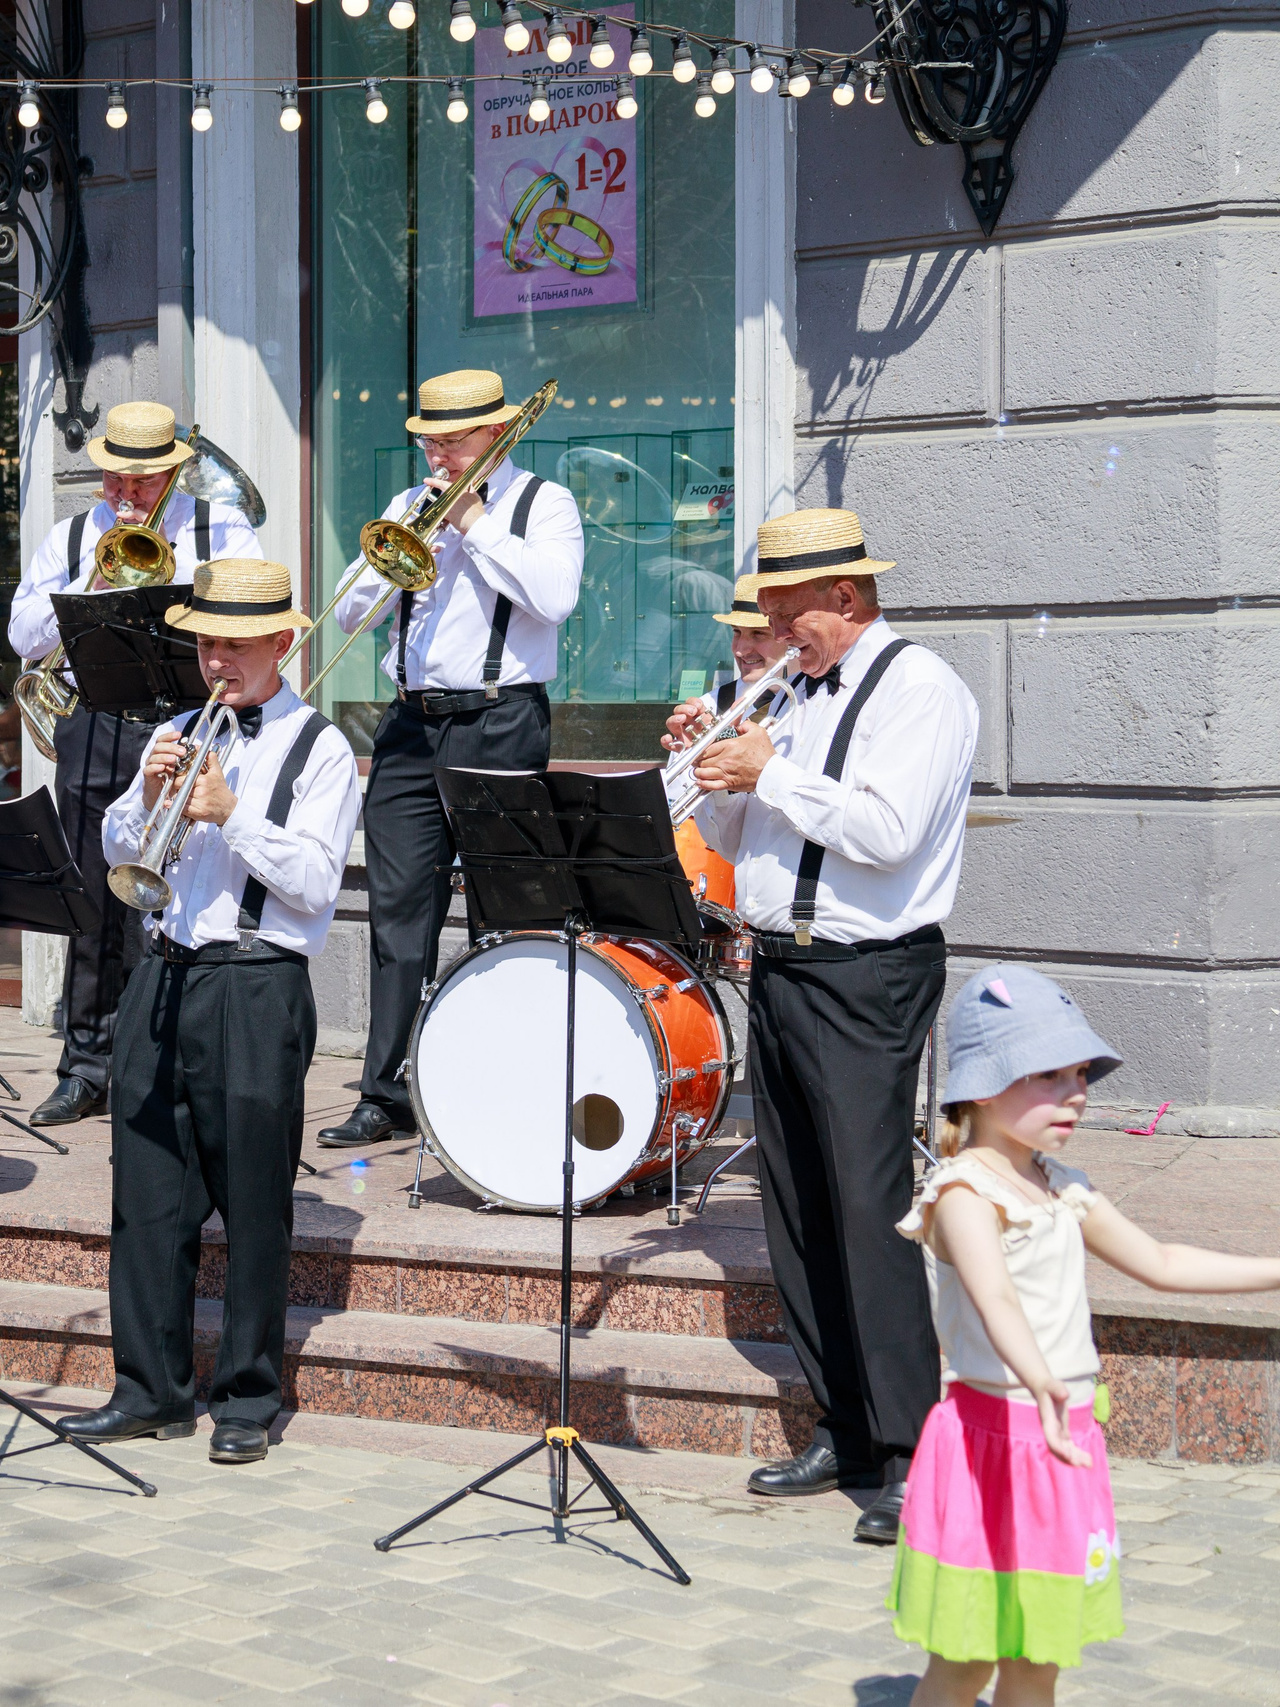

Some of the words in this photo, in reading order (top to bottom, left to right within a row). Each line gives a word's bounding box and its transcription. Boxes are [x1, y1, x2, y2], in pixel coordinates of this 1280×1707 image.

[522, 60, 589, 86] ВТОРОЕ
[483, 86, 574, 112] ОБРУЧАНОЕ
[577, 81, 617, 98] КОЛЬЦ
[491, 124, 502, 139] в
[506, 100, 623, 137] ПОДАРОК
[574, 147, 627, 195] 1=2
[518, 289, 569, 303] ИДЕАЛЬНАЯ
[571, 286, 593, 298] ПАРА
